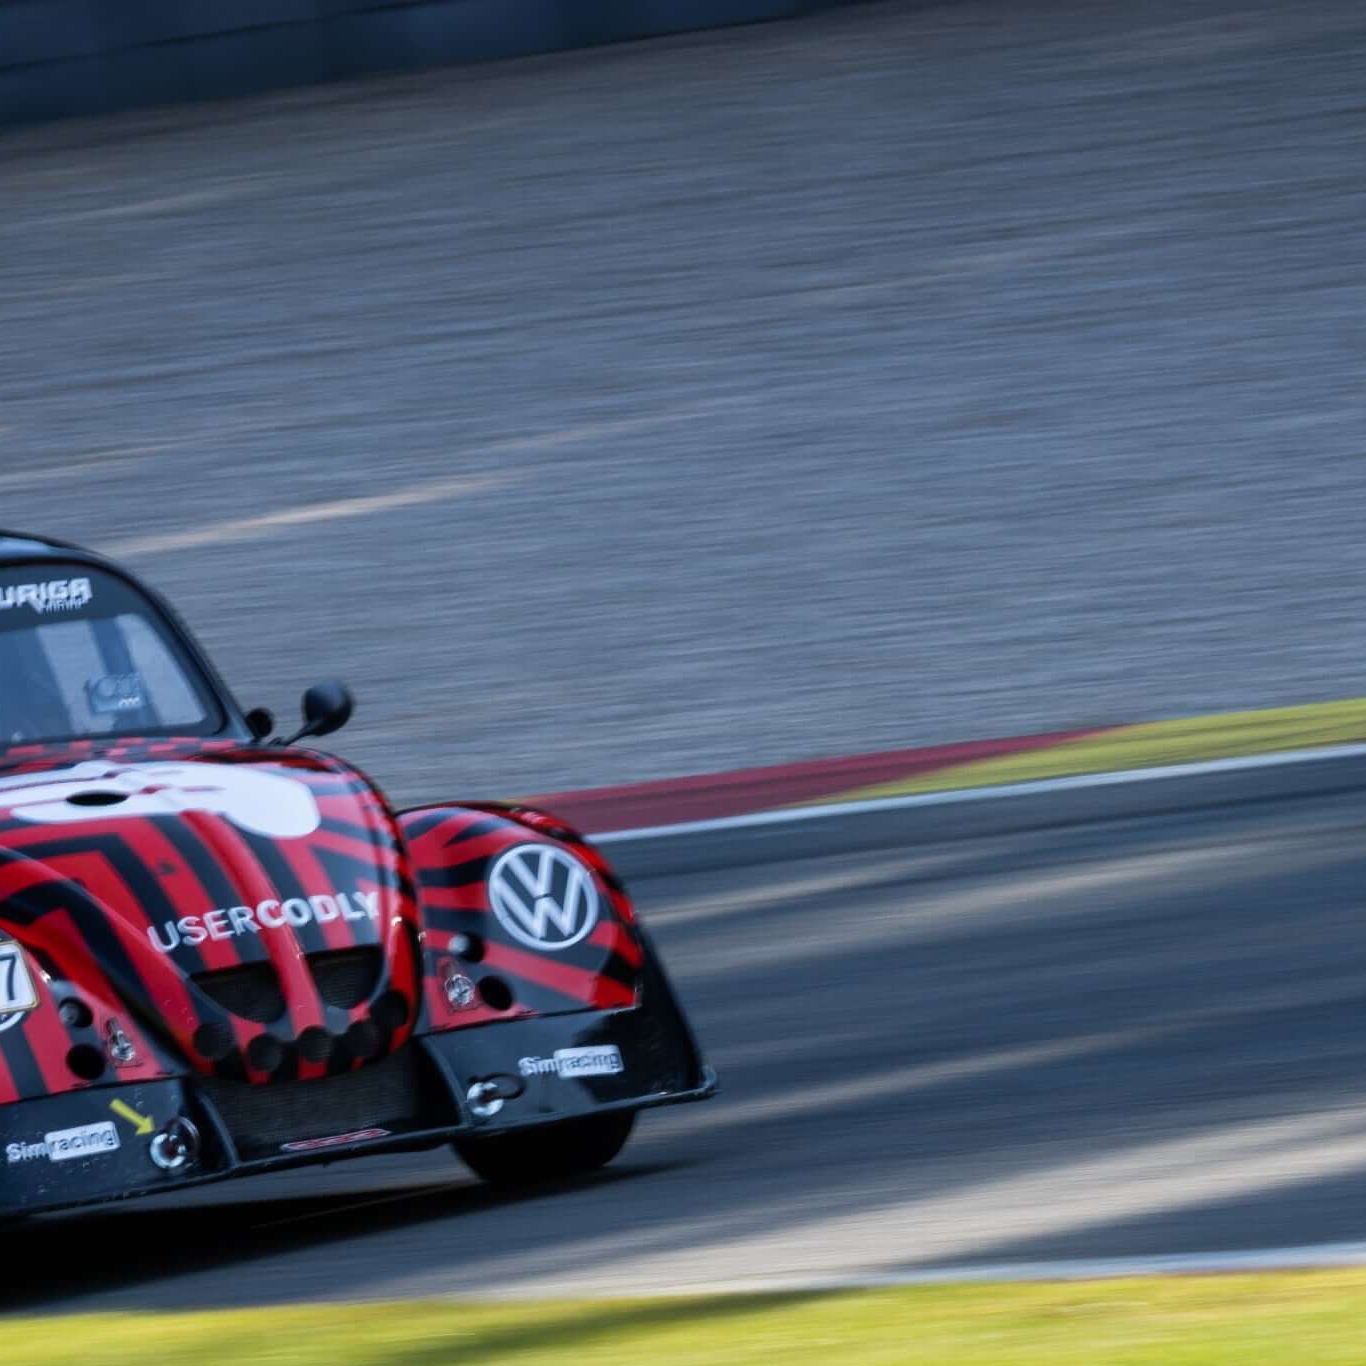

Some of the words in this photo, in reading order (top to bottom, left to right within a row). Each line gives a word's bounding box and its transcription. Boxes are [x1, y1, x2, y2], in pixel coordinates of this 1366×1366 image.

[490, 846, 590, 944] VW
[147, 891, 377, 953] USERCODLY
[518, 1051, 622, 1077] Simracing
[6, 1129, 119, 1163] Simracing
